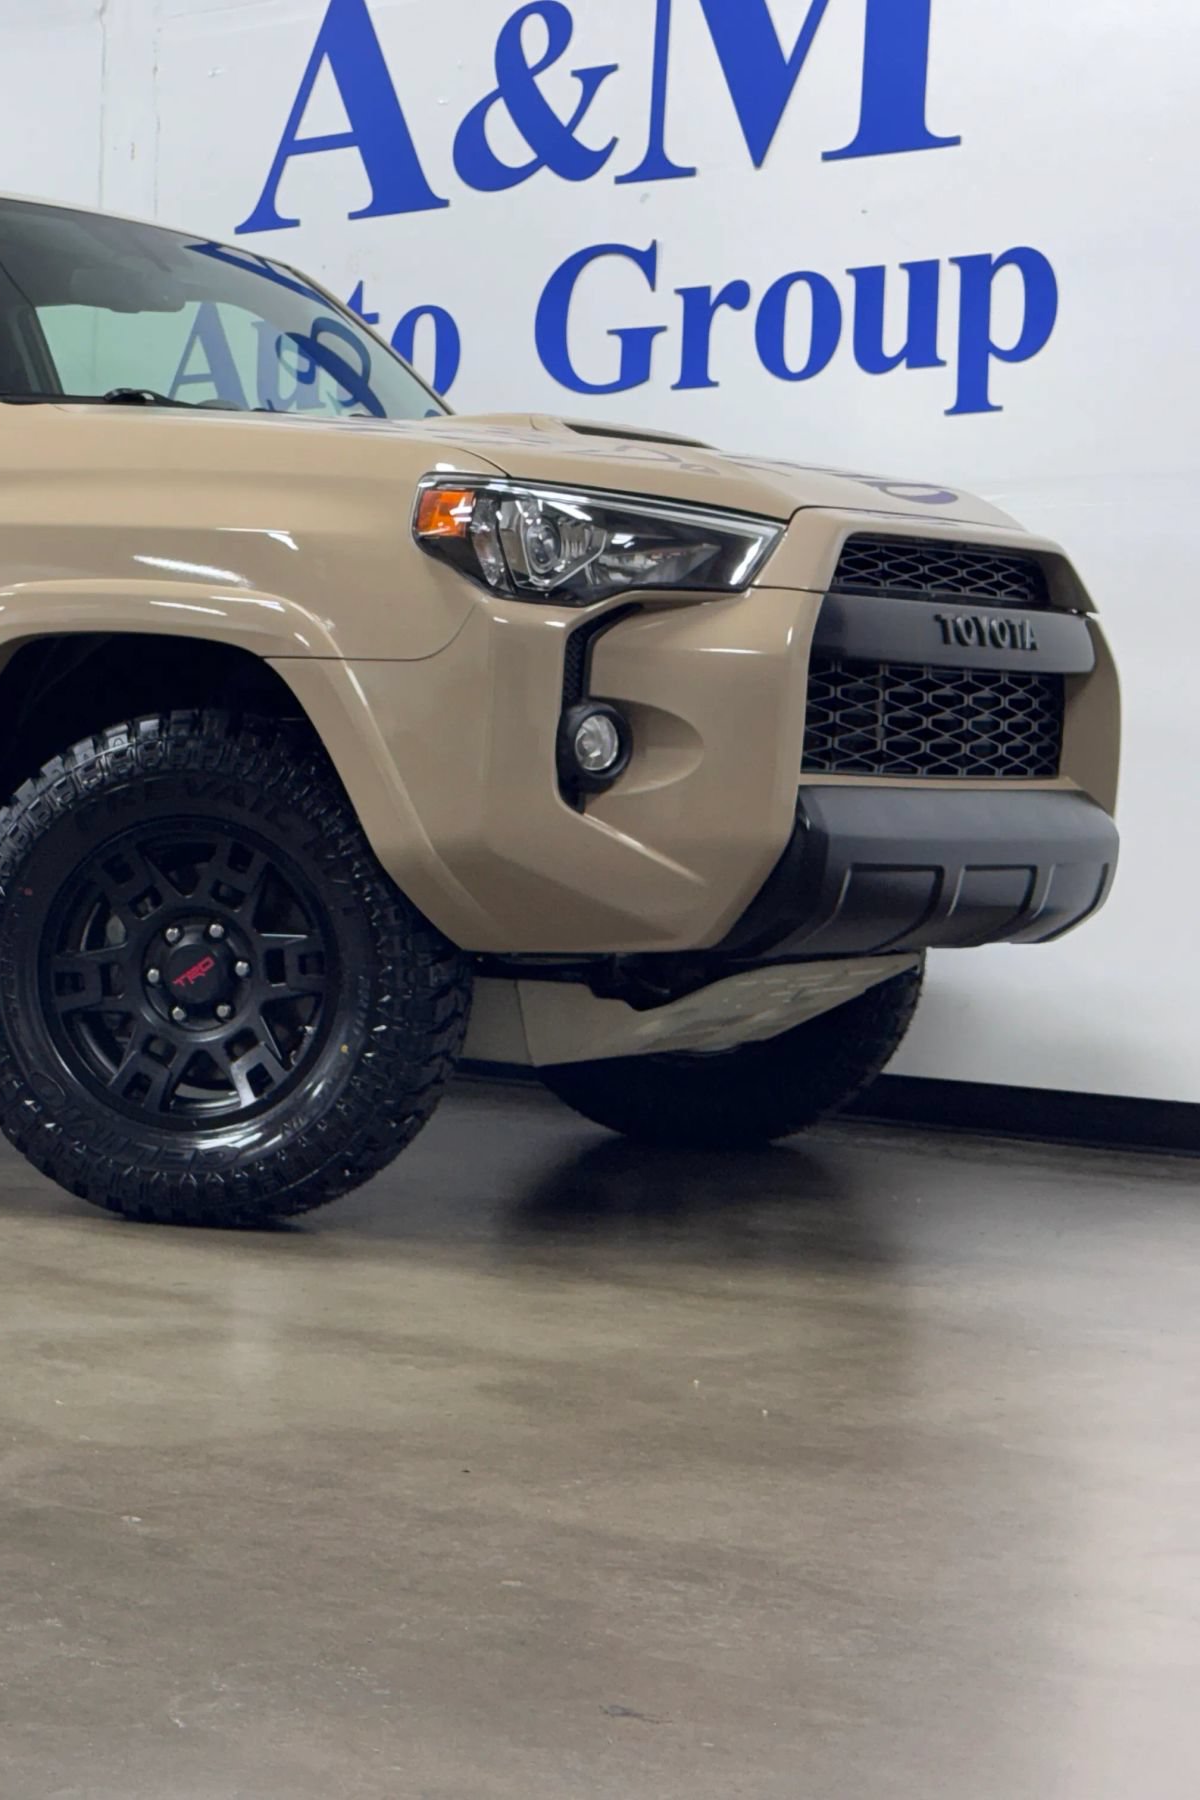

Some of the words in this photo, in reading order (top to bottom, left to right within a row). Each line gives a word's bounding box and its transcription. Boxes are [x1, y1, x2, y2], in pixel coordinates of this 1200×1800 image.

[234, 0, 961, 235] A&M
[533, 239, 1059, 416] Group
[933, 613, 1039, 651] TOYOTA
[172, 956, 215, 987] TRD
